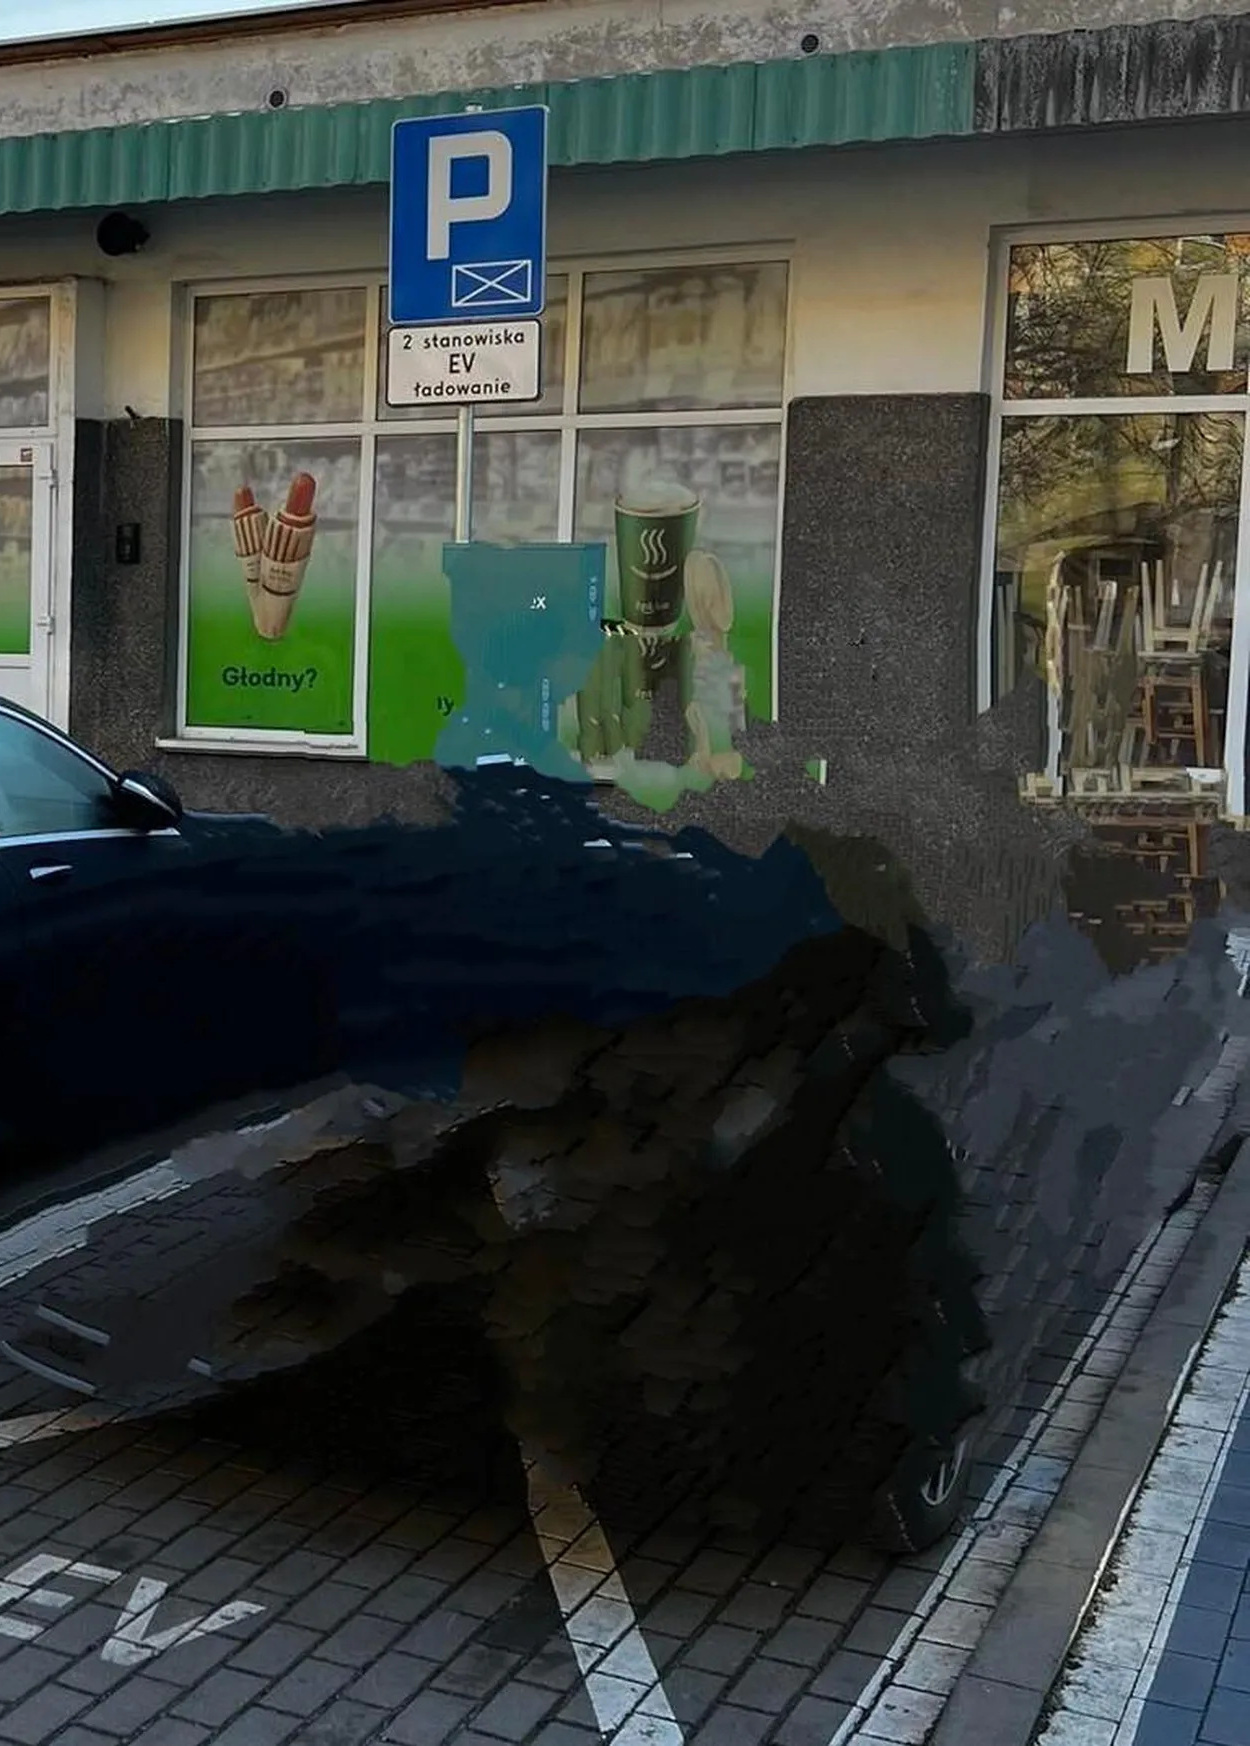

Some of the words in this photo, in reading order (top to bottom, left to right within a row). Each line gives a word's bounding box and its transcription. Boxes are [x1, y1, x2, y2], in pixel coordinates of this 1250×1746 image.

[427, 130, 513, 261] P
[1127, 274, 1239, 373] M
[402, 335, 412, 350] 2
[423, 329, 525, 349] stanowiska
[449, 352, 476, 374] EV
[414, 379, 511, 398] ładowanie
[222, 666, 318, 693] Głodny?
